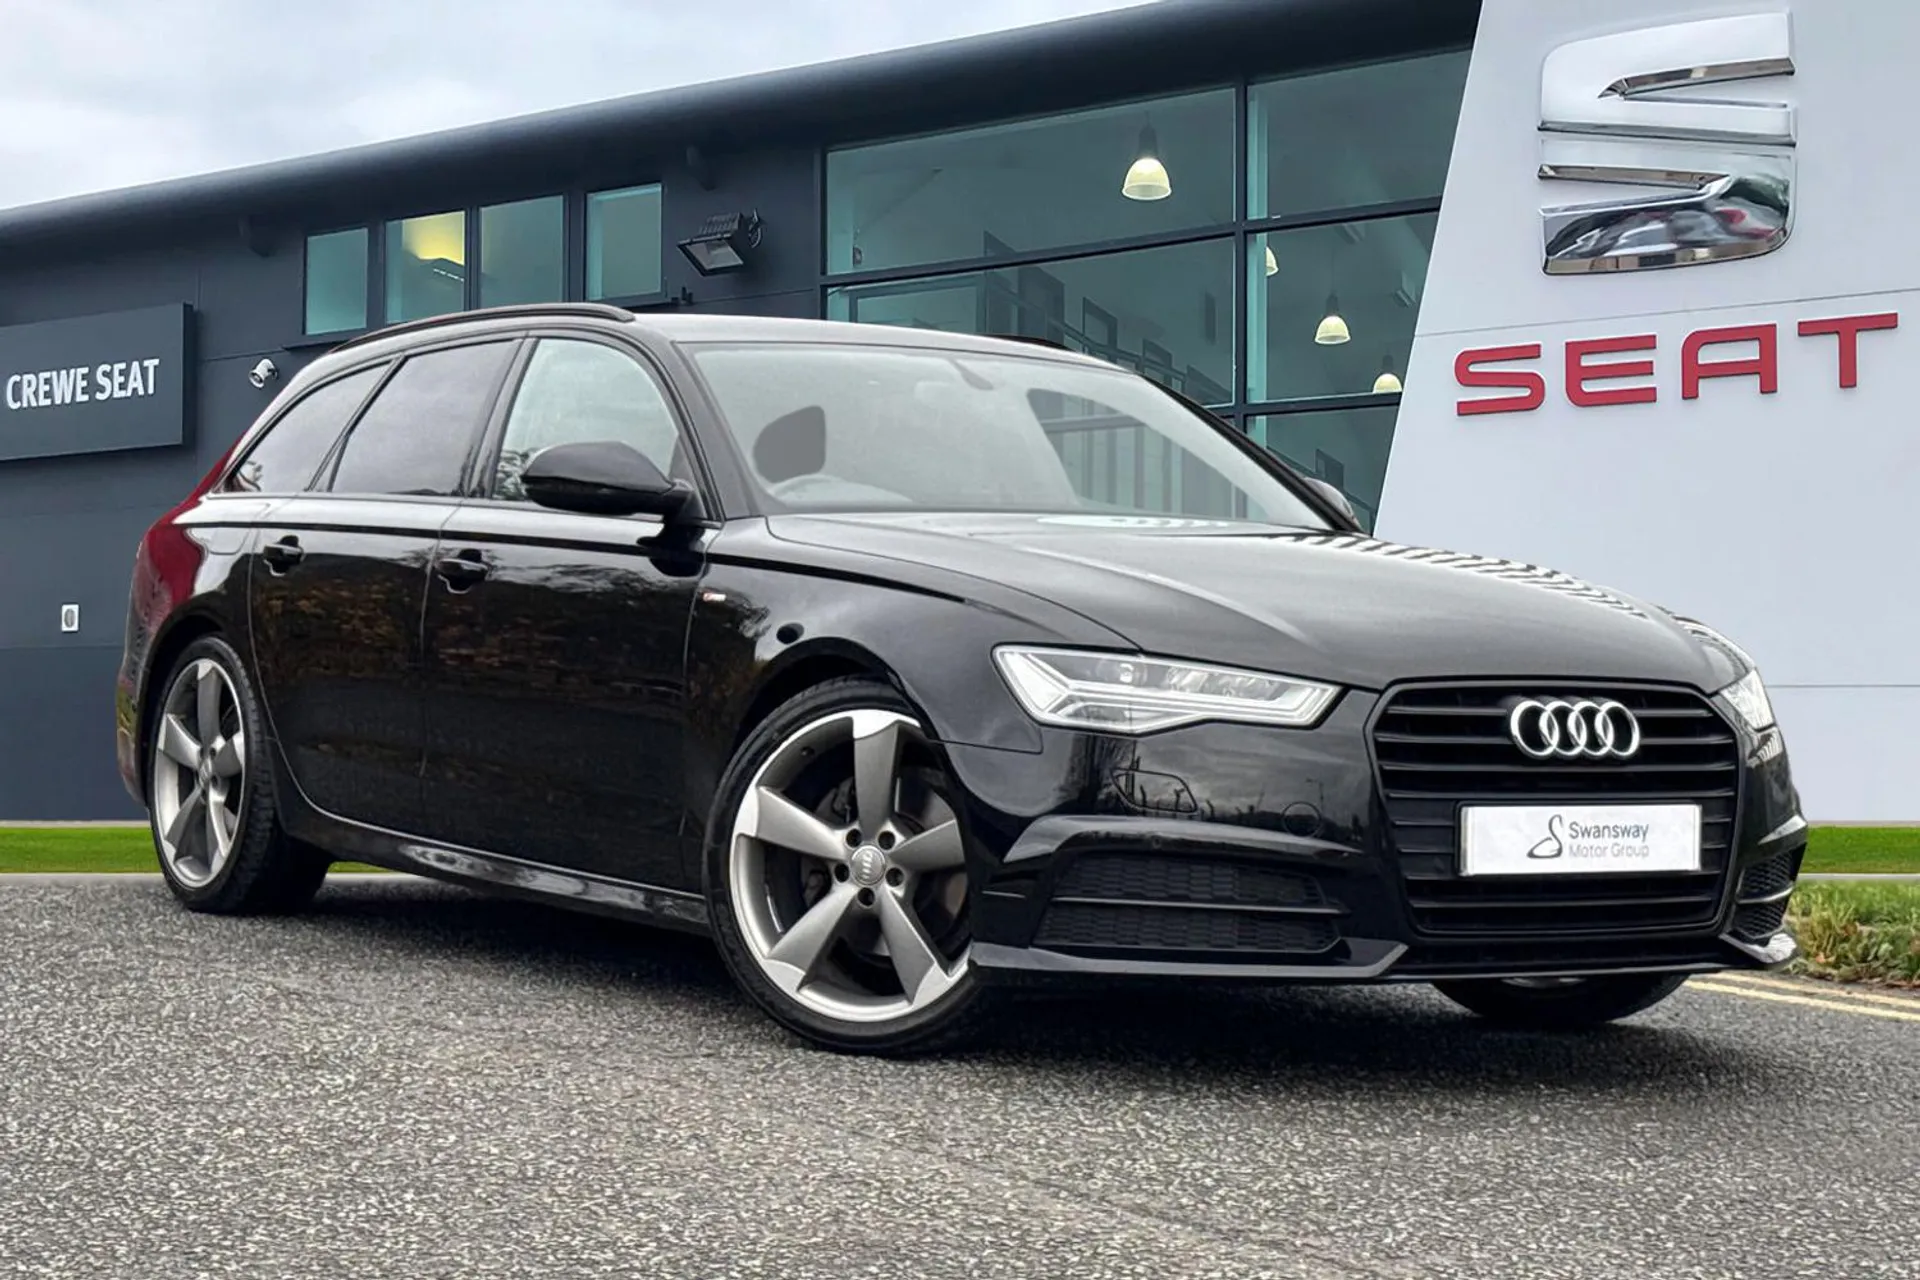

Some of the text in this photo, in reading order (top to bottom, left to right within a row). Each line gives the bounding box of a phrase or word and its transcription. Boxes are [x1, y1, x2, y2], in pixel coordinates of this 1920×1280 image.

[1454, 311, 1899, 416] SEAT
[6, 358, 160, 410] CREWE SEAT
[1568, 820, 1649, 842] Swansway
[1568, 842, 1650, 859] Motor Group
